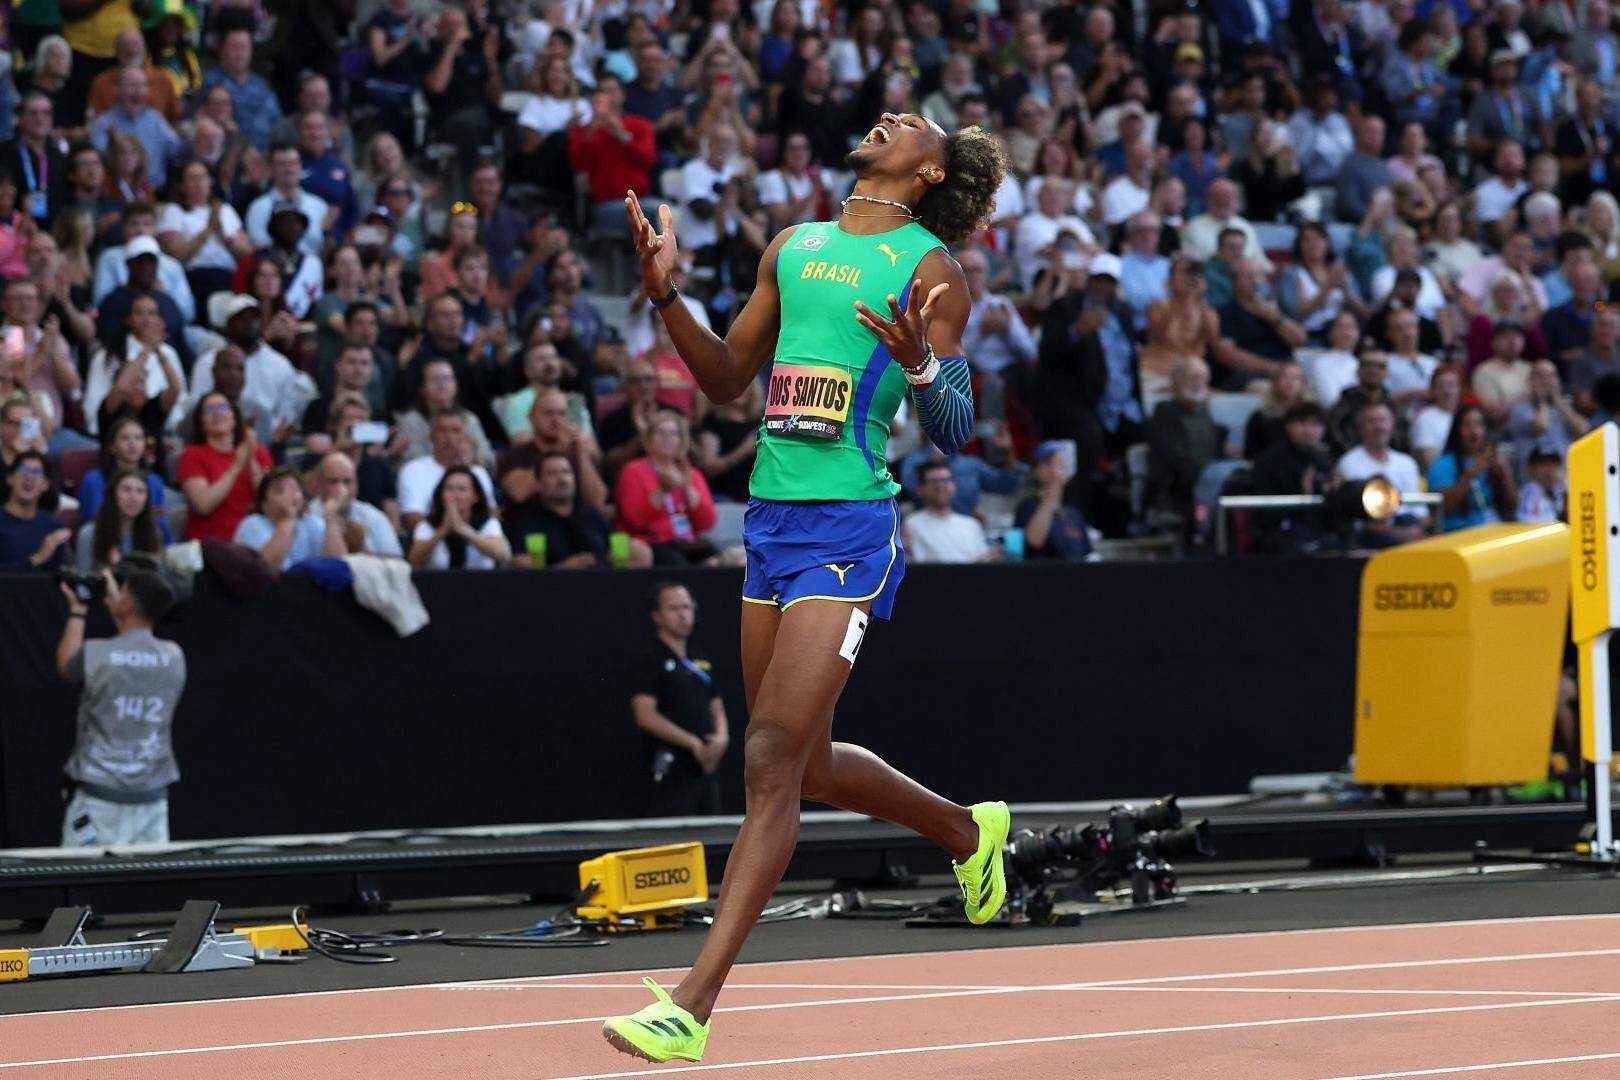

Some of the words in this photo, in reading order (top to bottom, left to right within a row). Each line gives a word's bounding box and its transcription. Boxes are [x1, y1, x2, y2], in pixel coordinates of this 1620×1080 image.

[801, 262, 861, 288] BRASIL
[770, 375, 791, 407] DOS
[792, 376, 849, 412] SANTOS
[798, 420, 827, 432] BUDAPEST
[1581, 491, 1597, 591] SEIKO
[1375, 582, 1457, 611] SEIKO
[109, 652, 171, 667] SONY
[113, 696, 164, 723] 142
[634, 866, 690, 889] SEIKO
